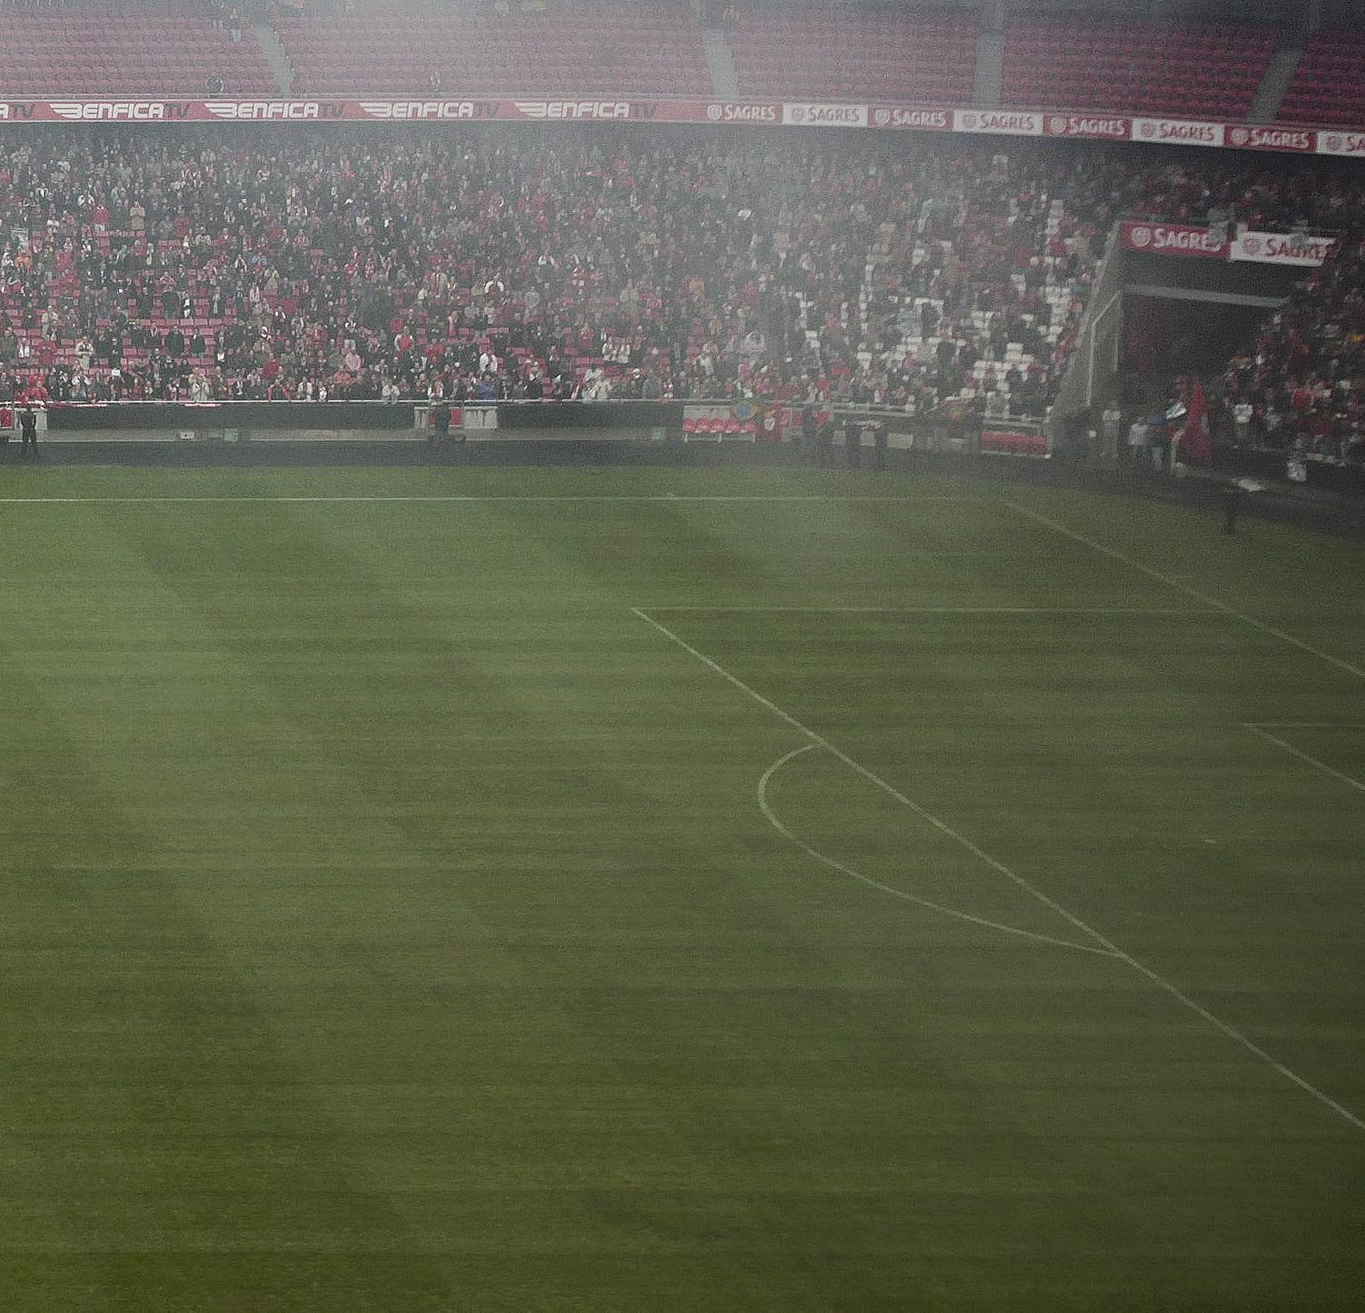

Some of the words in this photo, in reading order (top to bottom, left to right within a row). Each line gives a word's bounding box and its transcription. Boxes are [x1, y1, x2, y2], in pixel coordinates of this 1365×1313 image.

[48, 103, 165, 119] BENFICA
[203, 102, 319, 118] BENFICA
[359, 102, 474, 118] BENFICA
[514, 101, 630, 118] BENFICA
